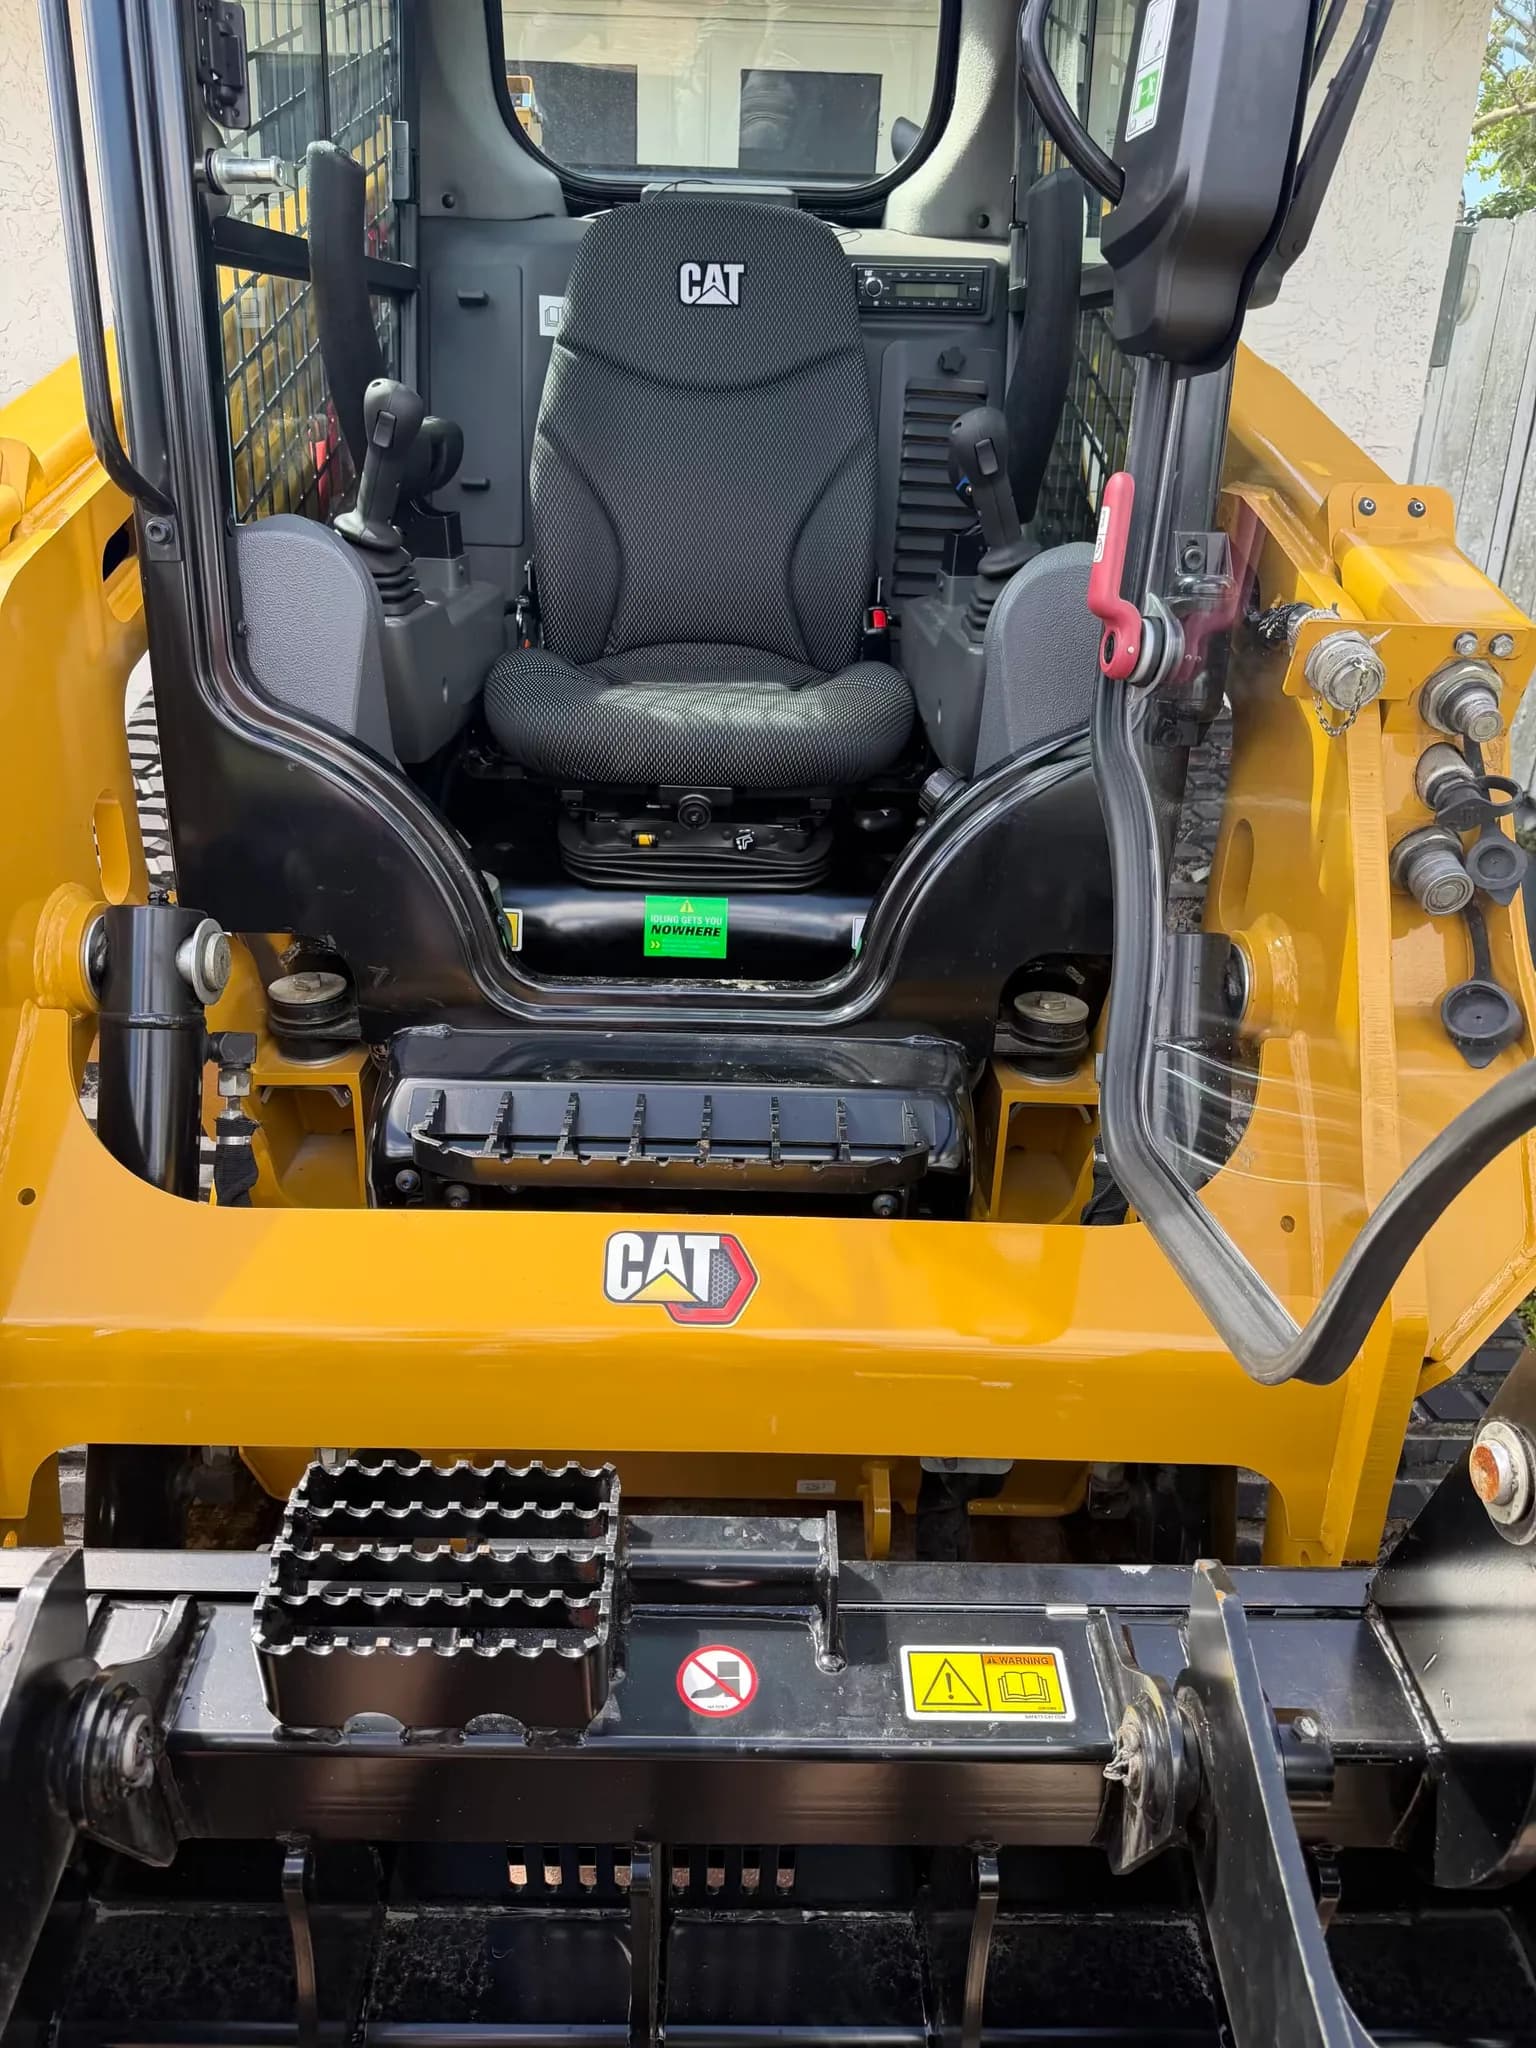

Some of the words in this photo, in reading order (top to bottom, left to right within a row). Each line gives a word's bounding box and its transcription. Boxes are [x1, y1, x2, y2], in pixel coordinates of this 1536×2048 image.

[681, 262, 745, 305] CAT
[650, 914, 679, 925] IDLING
[681, 915, 703, 925] GETS
[705, 916, 723, 926] YOU
[650, 924, 722, 937] NOWHERE
[606, 1232, 721, 1302] CAT
[999, 1656, 1049, 1665] WARNING
